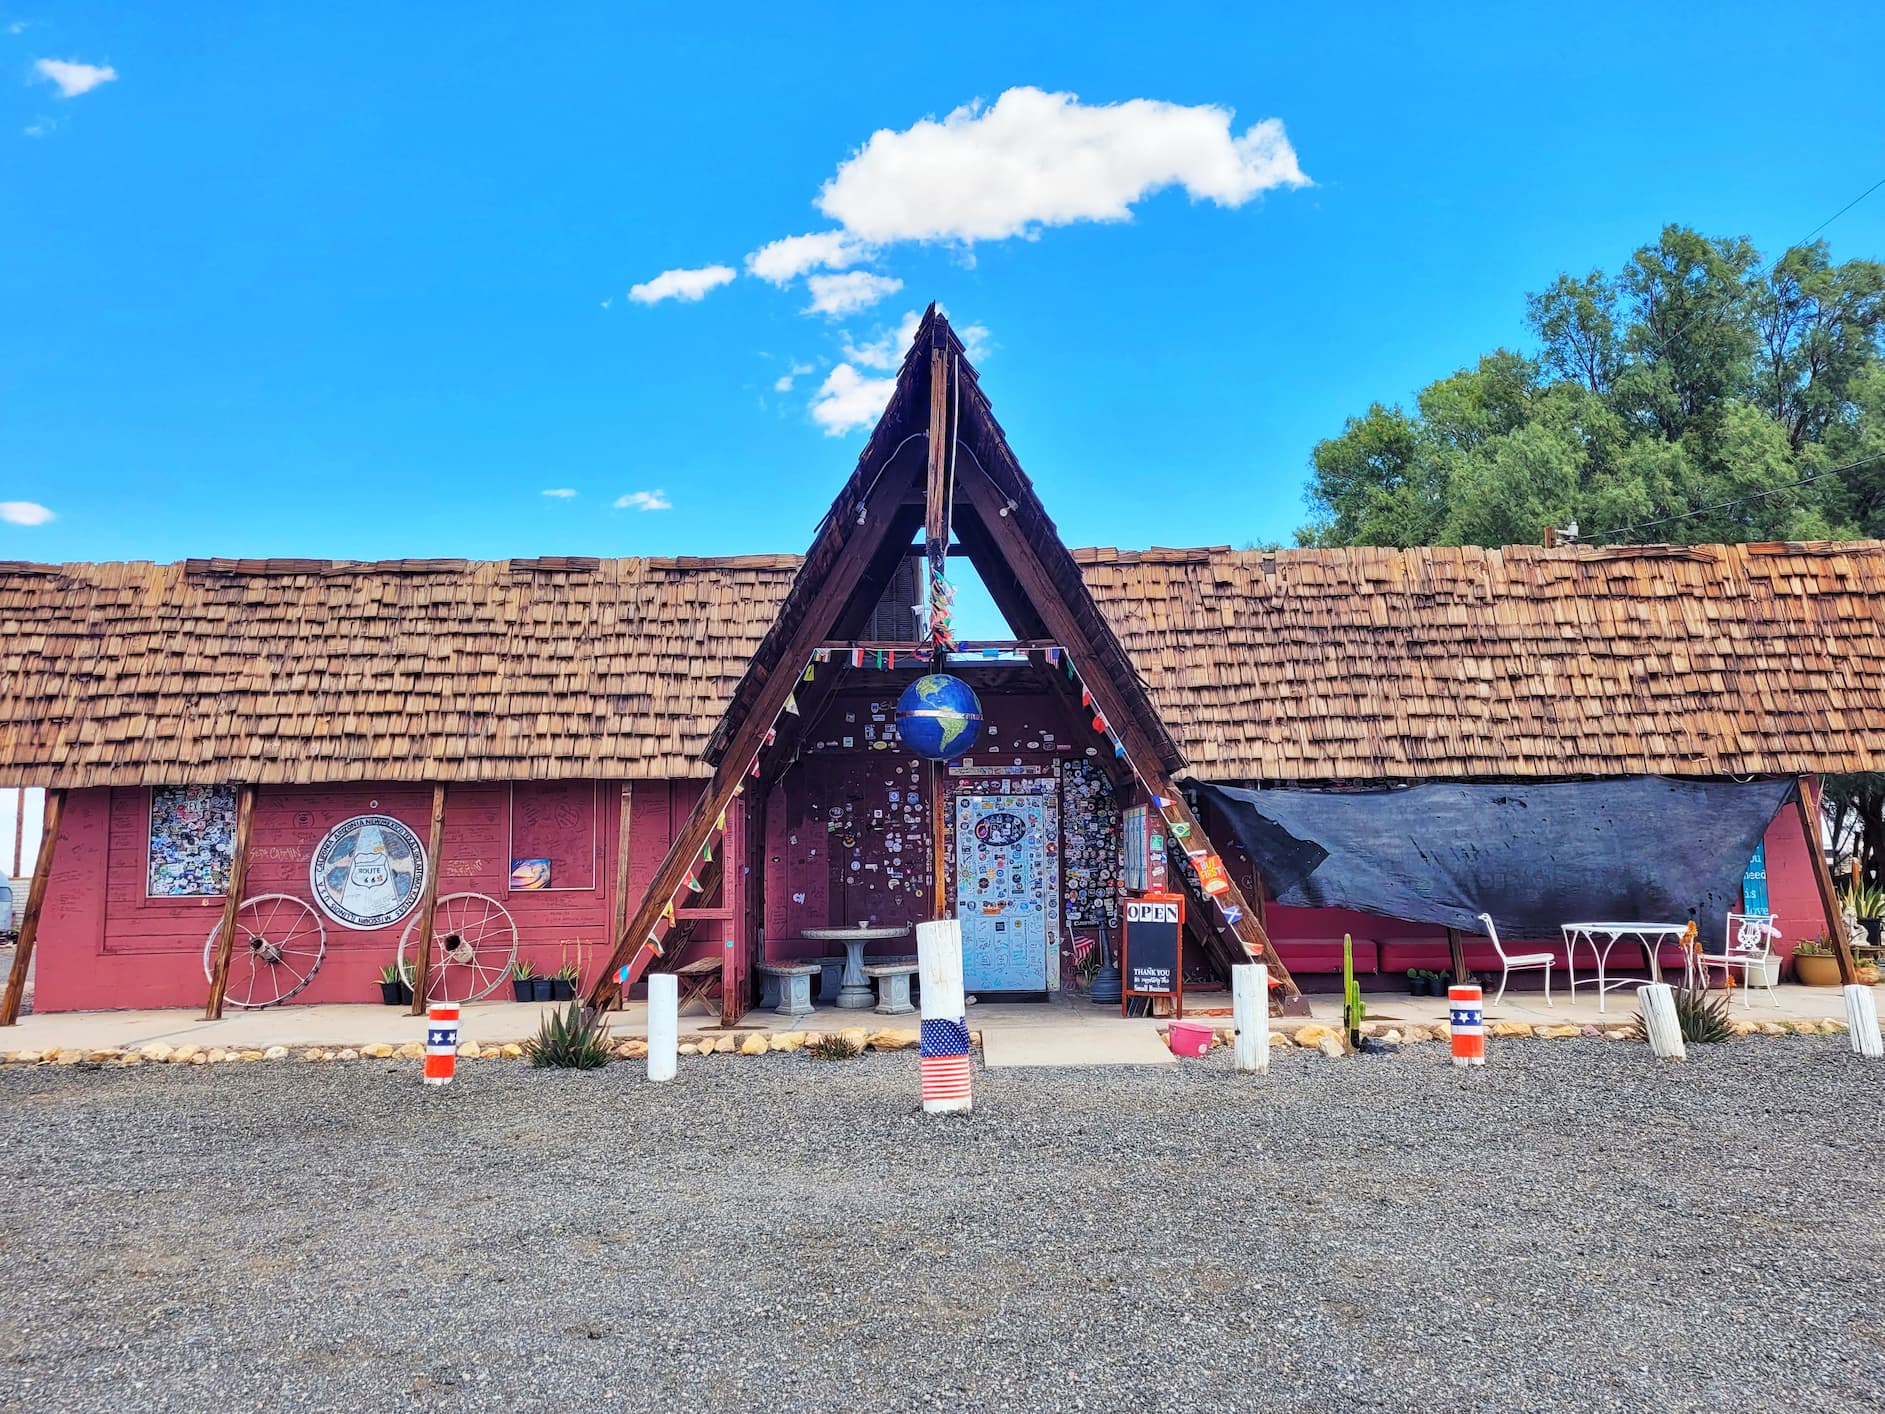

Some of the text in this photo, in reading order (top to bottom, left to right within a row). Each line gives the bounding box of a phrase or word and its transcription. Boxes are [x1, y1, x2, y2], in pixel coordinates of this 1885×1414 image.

[1744, 869, 1766, 880] need
[1744, 887, 1756, 899] is
[1127, 905, 1178, 921] OPEN
[1745, 905, 1769, 916] love
[1134, 967, 1156, 976] THANK
